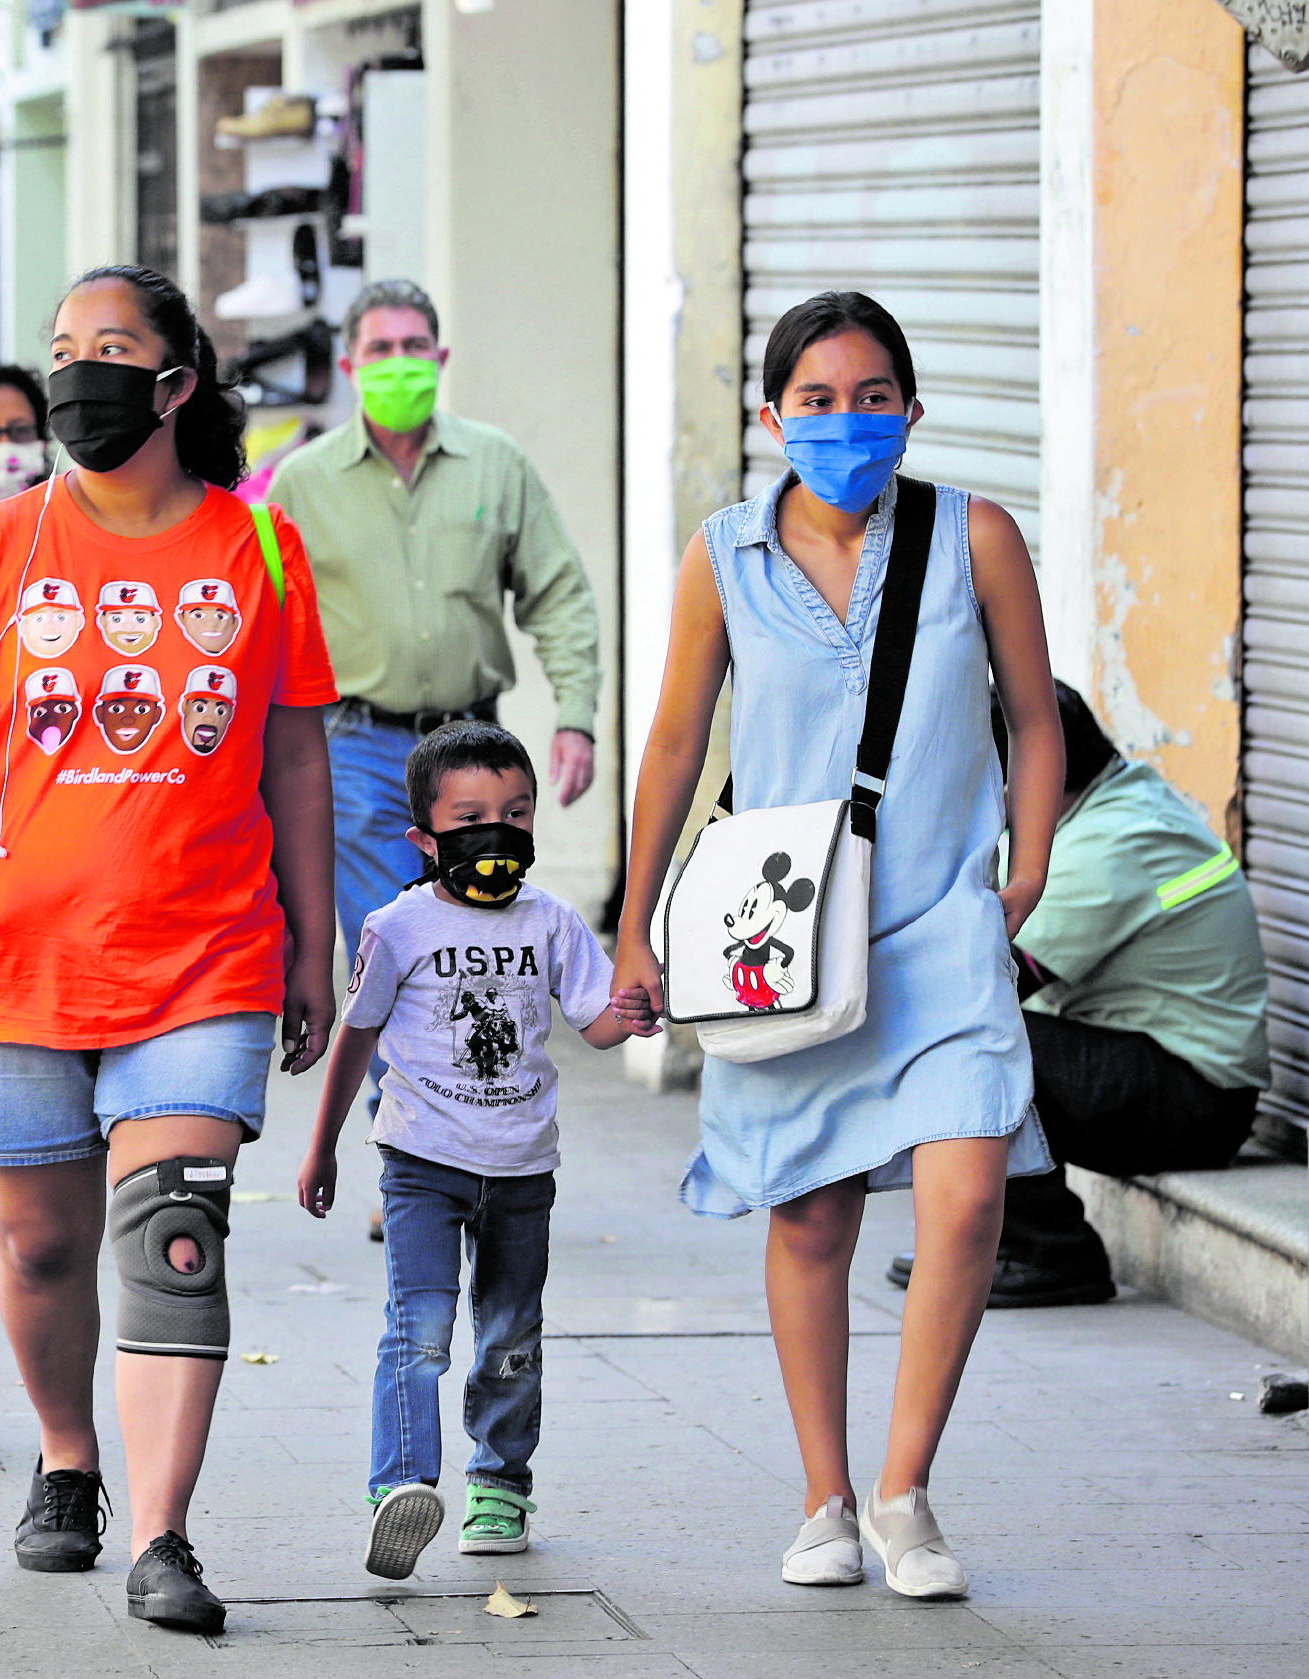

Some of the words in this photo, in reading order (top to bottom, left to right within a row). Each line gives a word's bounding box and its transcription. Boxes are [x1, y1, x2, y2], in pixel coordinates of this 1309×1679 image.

[55, 767, 186, 785] #BirdlandPowerCo
[432, 946, 539, 978] USPA
[454, 1077, 542, 1108] CHAMPIONSHI
[483, 1084, 520, 1096] OPEN
